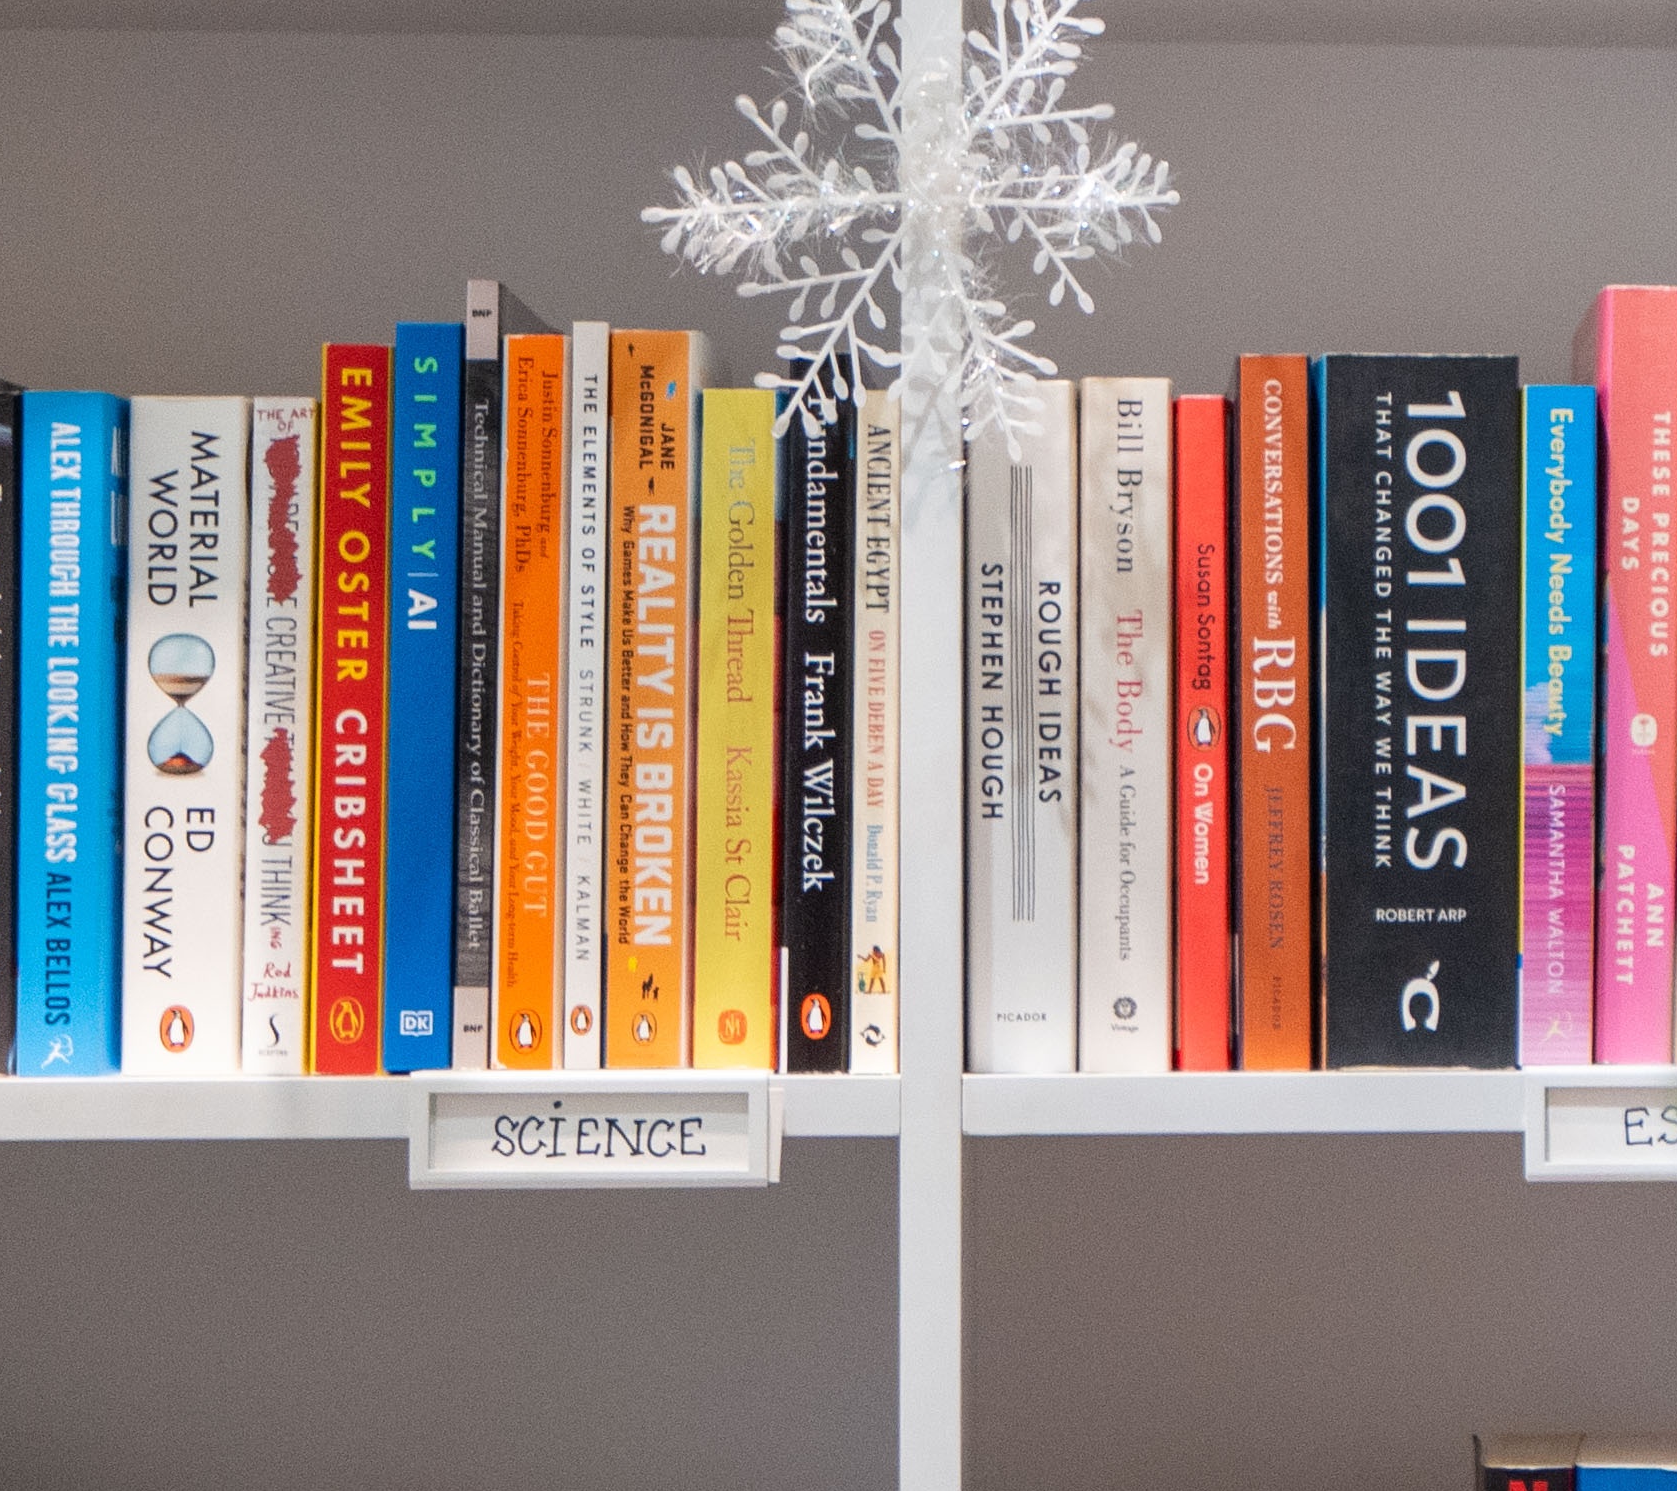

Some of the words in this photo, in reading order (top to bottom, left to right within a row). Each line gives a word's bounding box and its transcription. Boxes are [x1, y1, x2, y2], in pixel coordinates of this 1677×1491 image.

[339, 367, 372, 509] EMILY
[411, 356, 438, 560] SIMPLY
[1406, 390, 1466, 586] 1001
[1652, 412, 1671, 497] THESE
[148, 469, 178, 607] WORLD
[189, 431, 221, 608] MATERIAL
[1622, 497, 1640, 572] DAYS
[336, 531, 370, 682] OSTER
[407, 589, 437, 630] AI
[636, 504, 676, 692] REALITY
[981, 564, 1003, 689] STEPHEN
[1038, 582, 1062, 696] ROUGH
[1649, 512, 1670, 658] PRECIOUS
[635, 701, 674, 750] IS
[981, 705, 1005, 819] HOUGH
[1038, 712, 1063, 804] IDEAS
[1192, 763, 1213, 796] On
[1404, 618, 1468, 870] IDEAS
[186, 807, 214, 853] ED
[331, 709, 368, 975] CRIBSHEET
[633, 764, 673, 947] BROKEN
[1192, 802, 1213, 886] Women
[46, 871, 71, 929] ALEX
[142, 806, 174, 979] CONWAY
[1376, 908, 1435, 922] ROBERT
[1437, 909, 1467, 922] ARP
[44, 936, 71, 1026] BELLOS
